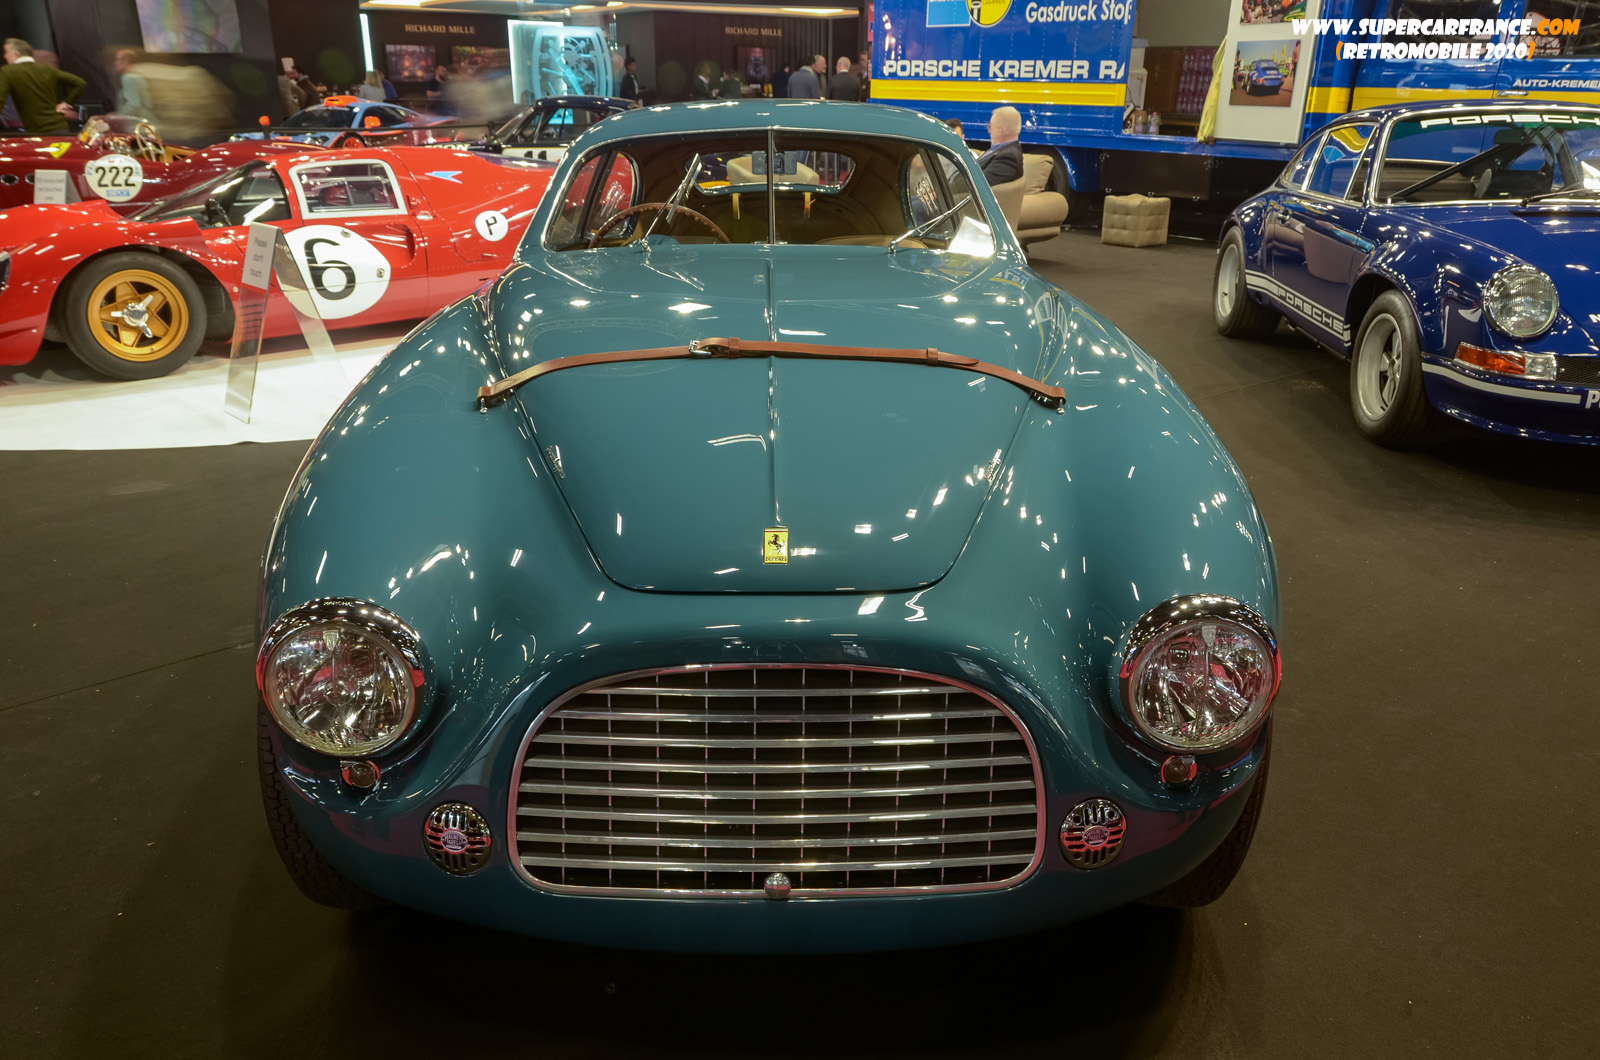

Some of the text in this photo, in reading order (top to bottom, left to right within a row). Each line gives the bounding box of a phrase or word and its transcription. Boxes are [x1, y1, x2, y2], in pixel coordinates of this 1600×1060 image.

[1025, 0, 1097, 23] Gasdruck
[405, 24, 476, 34] RICHARD MILLE
[725, 26, 783, 37] RICHARD MILLE
[884, 60, 982, 78] PORSCHE
[988, 60, 1090, 79] KREMER
[1513, 78, 1600, 89] AUTO-KREME
[95, 166, 136, 188] 222
[485, 216, 498, 236] P
[304, 238, 356, 301] 6
[1278, 287, 1344, 334] PORSCHE
